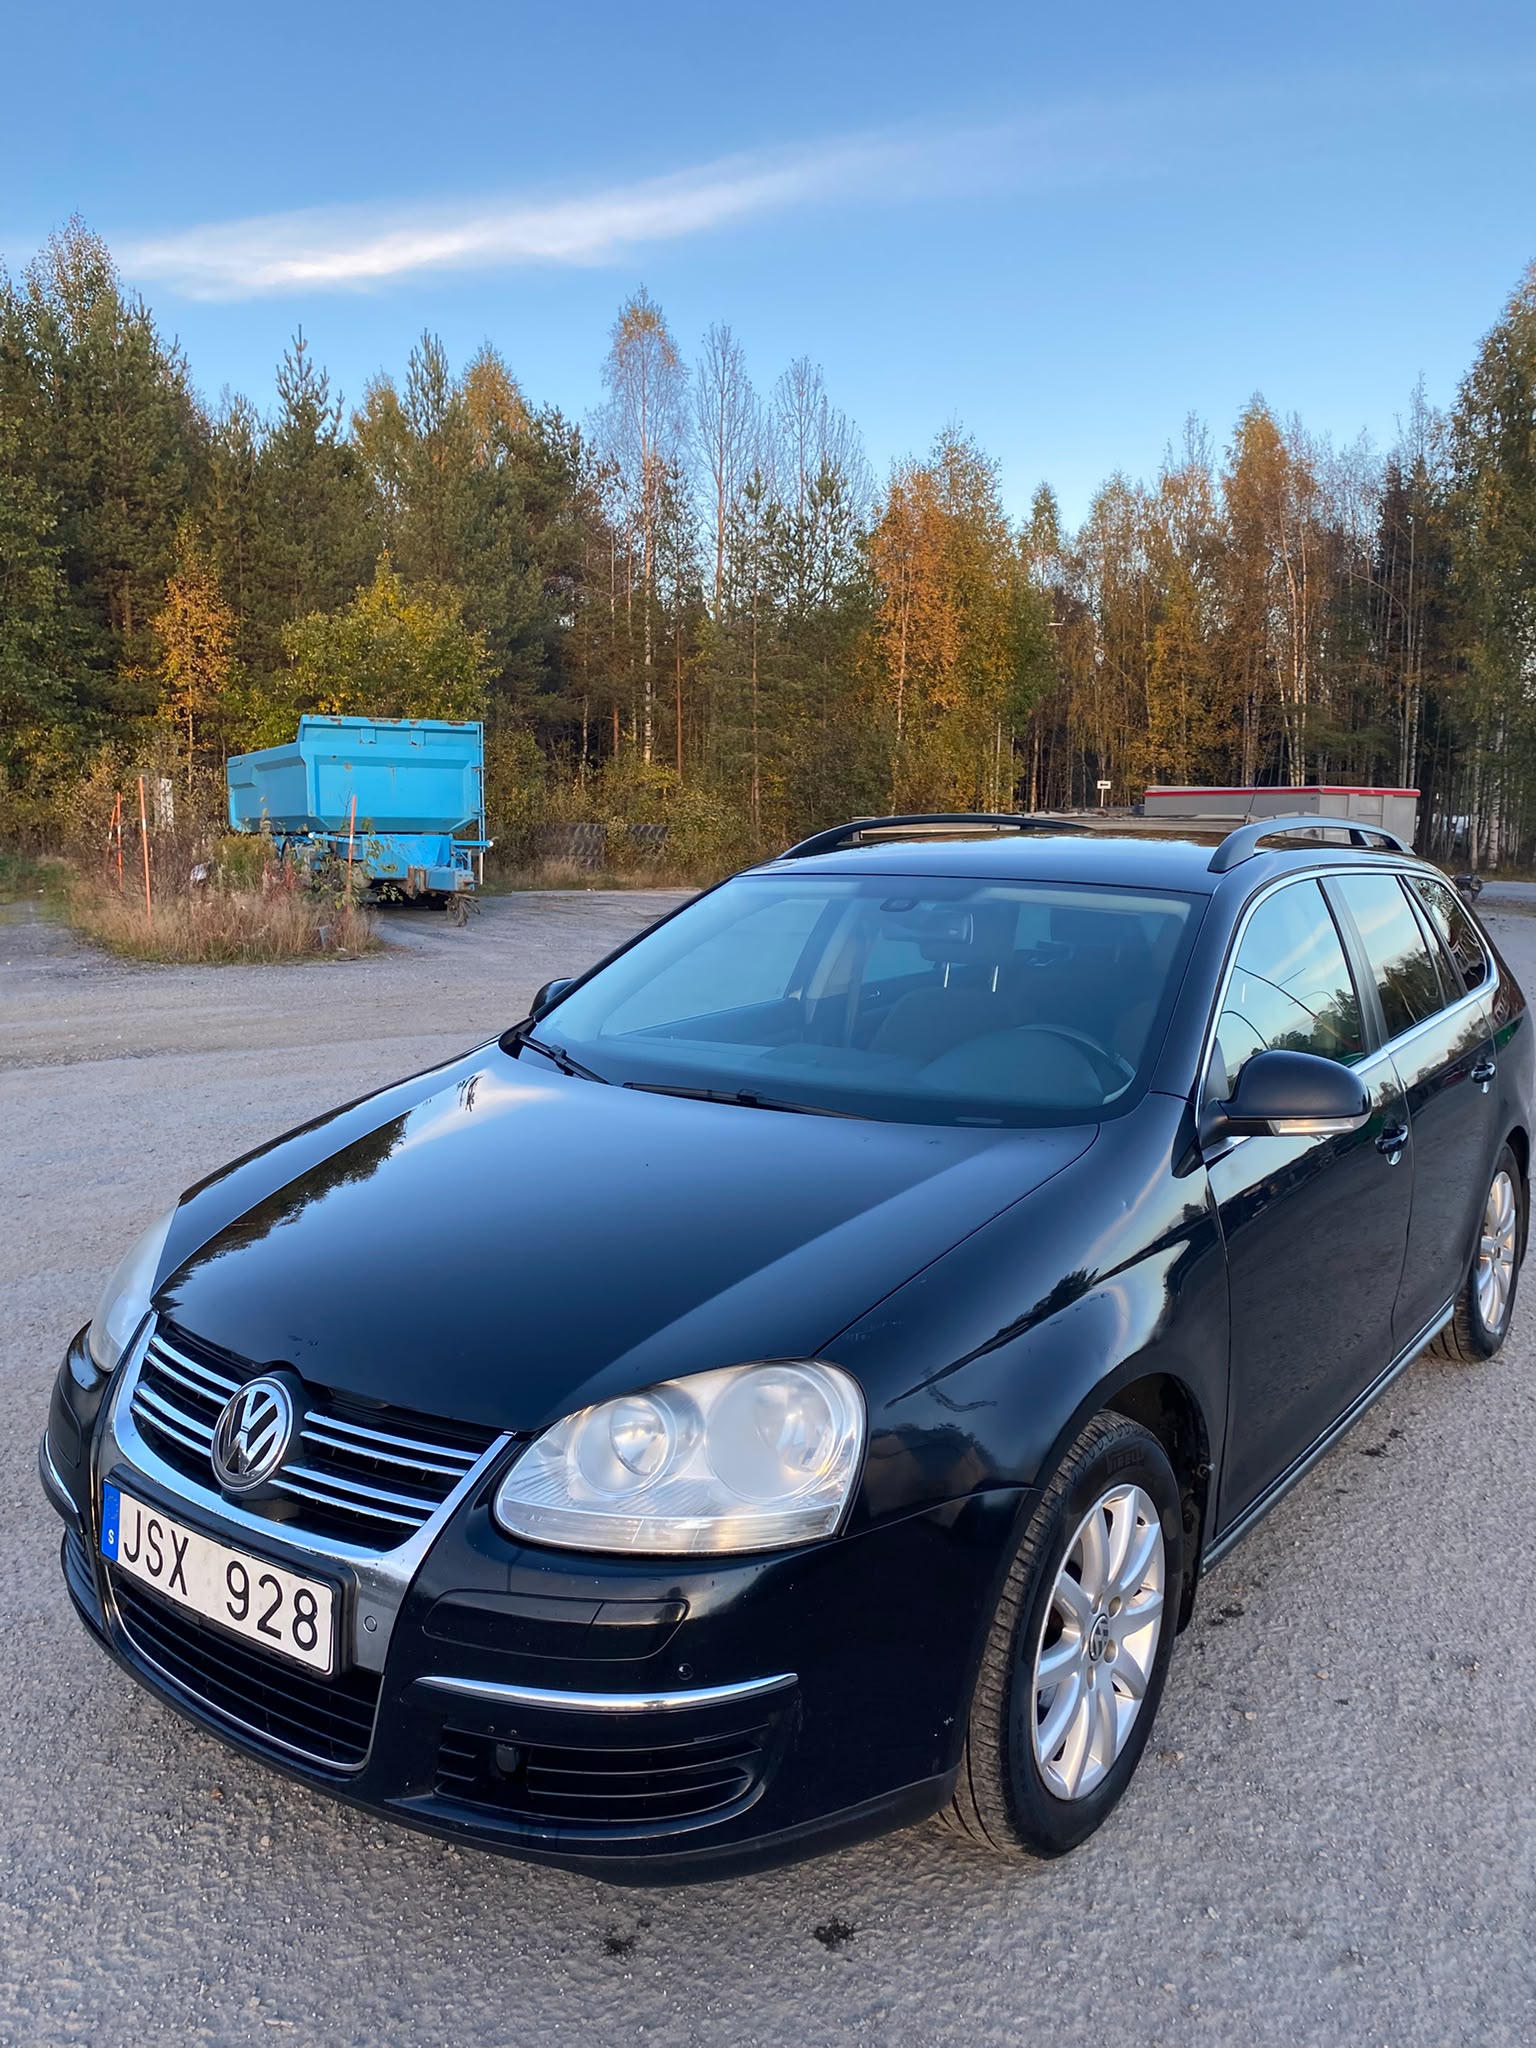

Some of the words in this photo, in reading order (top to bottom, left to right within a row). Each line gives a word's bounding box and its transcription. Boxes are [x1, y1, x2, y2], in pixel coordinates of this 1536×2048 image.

[108, 1529, 115, 1545] S
[123, 1509, 190, 1597] JSX
[225, 1560, 318, 1652] 928
